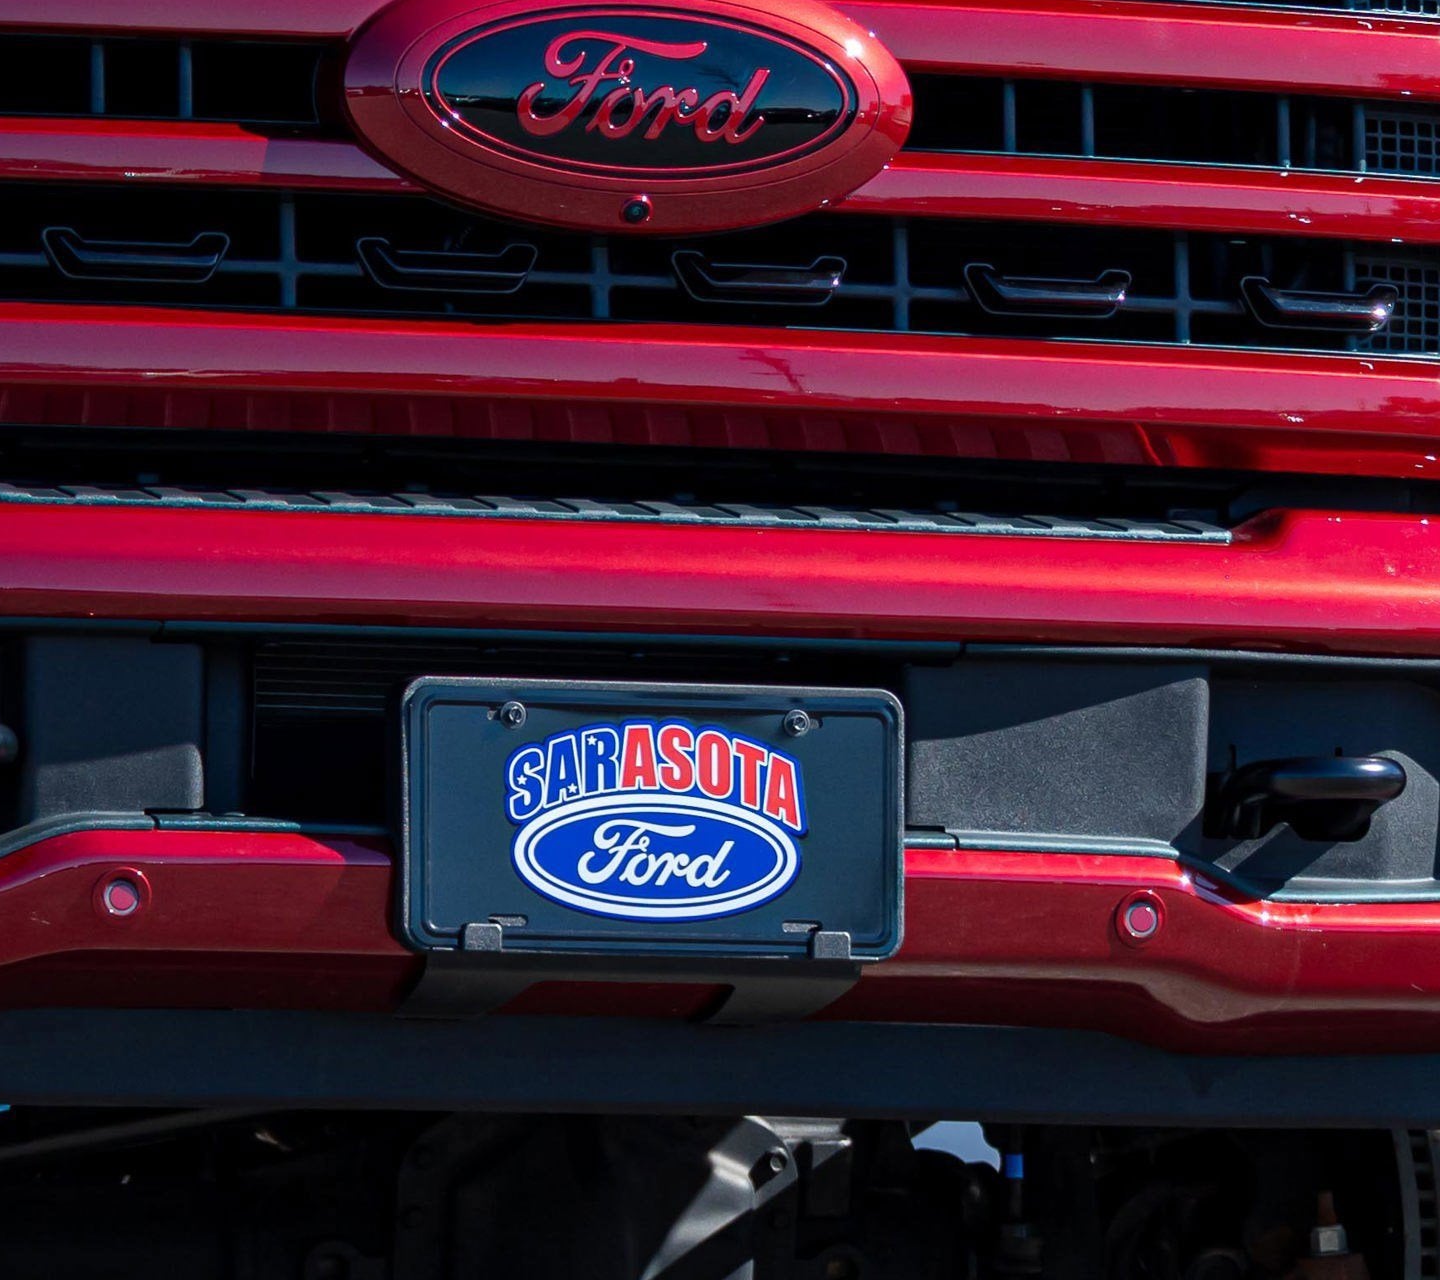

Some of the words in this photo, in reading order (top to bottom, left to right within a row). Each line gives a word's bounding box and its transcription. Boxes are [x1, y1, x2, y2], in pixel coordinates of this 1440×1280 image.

[517, 29, 771, 145] Ford
[507, 722, 804, 832] SARASOTA
[576, 818, 735, 889] Ford
